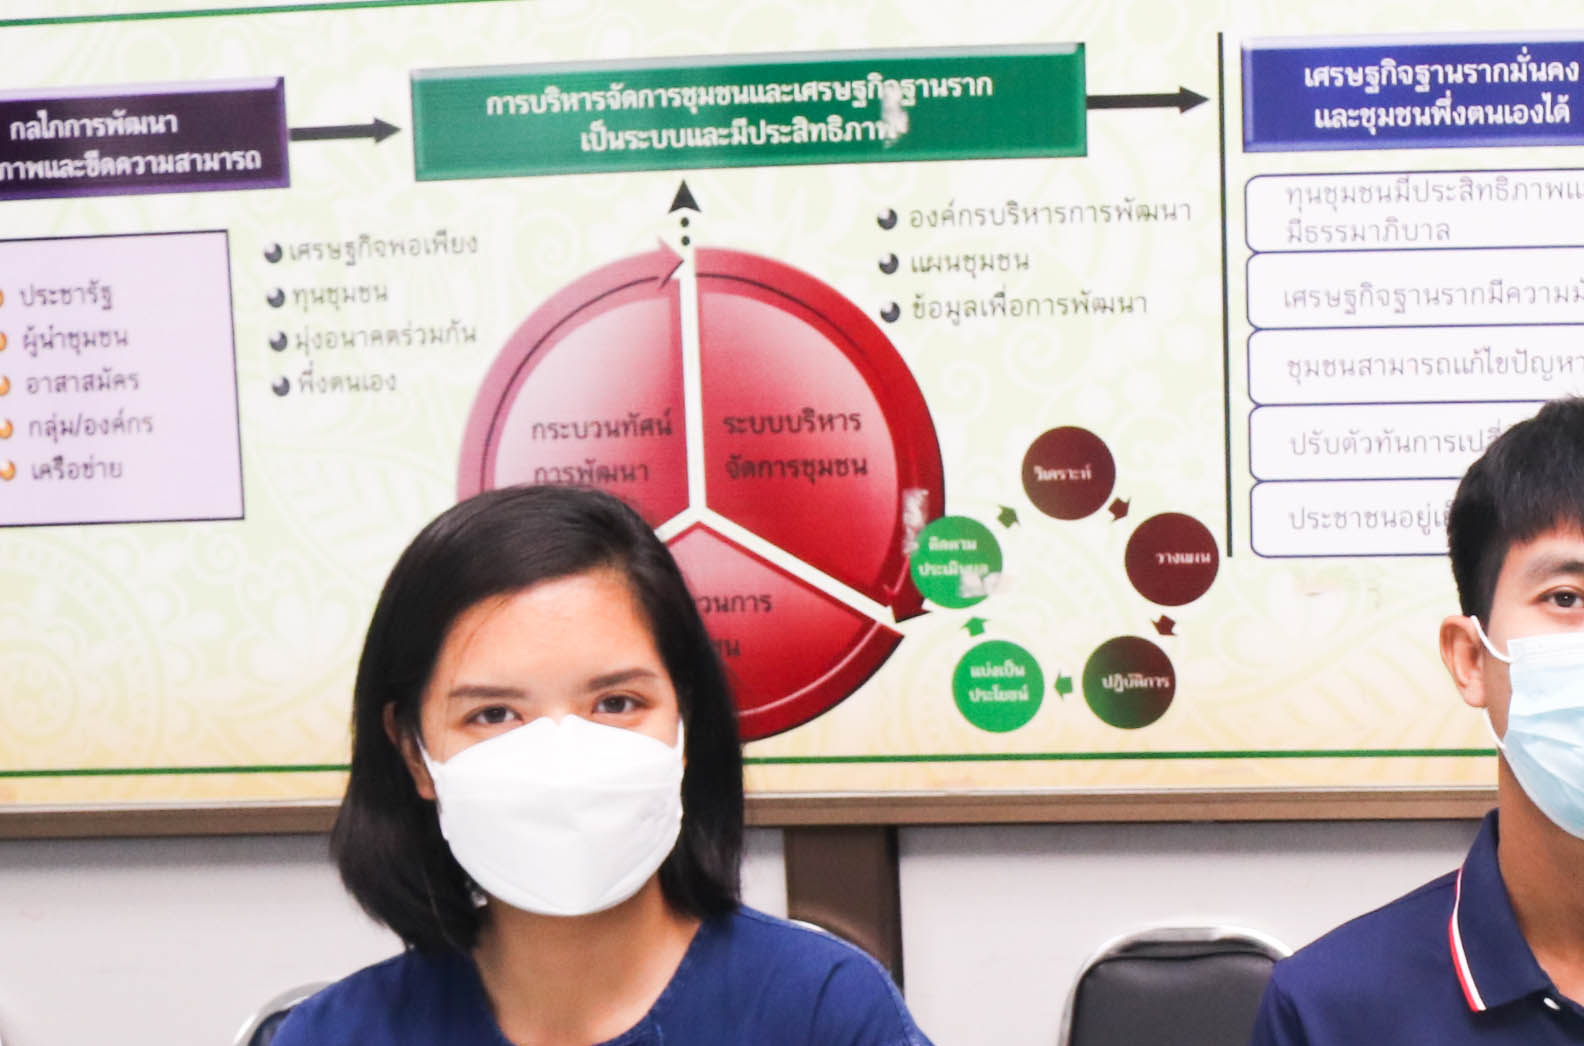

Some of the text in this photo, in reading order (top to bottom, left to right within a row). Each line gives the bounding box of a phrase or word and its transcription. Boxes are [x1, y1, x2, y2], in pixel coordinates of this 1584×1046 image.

[1304, 46, 1580, 94] เศรษฐกิจฐานรากมั่นคง
[10, 109, 179, 141] กลไกการพัฒนา
[1314, 90, 1571, 136] และชุมชนพึ่งตนเองได้
[909, 197, 1192, 229] องค์กรบริหารการพัฒนา
[289, 229, 479, 267] เศรษฐกิจพอเพียง
[1286, 218, 1451, 246] มีธรรมาภิบาล
[910, 252, 1030, 280] แผนชุมชน
[19, 279, 113, 312] ประชารัฐ
[292, 285, 390, 313] ทุนชุมชน
[912, 285, 1148, 326] ข้อมูลเพื่อการพัฒนา
[22, 325, 129, 358] ผู้นำชุมชน
[26, 366, 141, 395] อาสาสมัคร
[299, 360, 397, 394] พึ่งตนเอง
[28, 408, 156, 444] กลุ่ม/องค์กร
[531, 407, 673, 442] กระบวนทัศน์
[723, 407, 862, 435] ระบบบริหาร
[31, 454, 124, 481] เครือข่าย
[725, 452, 868, 485] จัดการชุมชน
